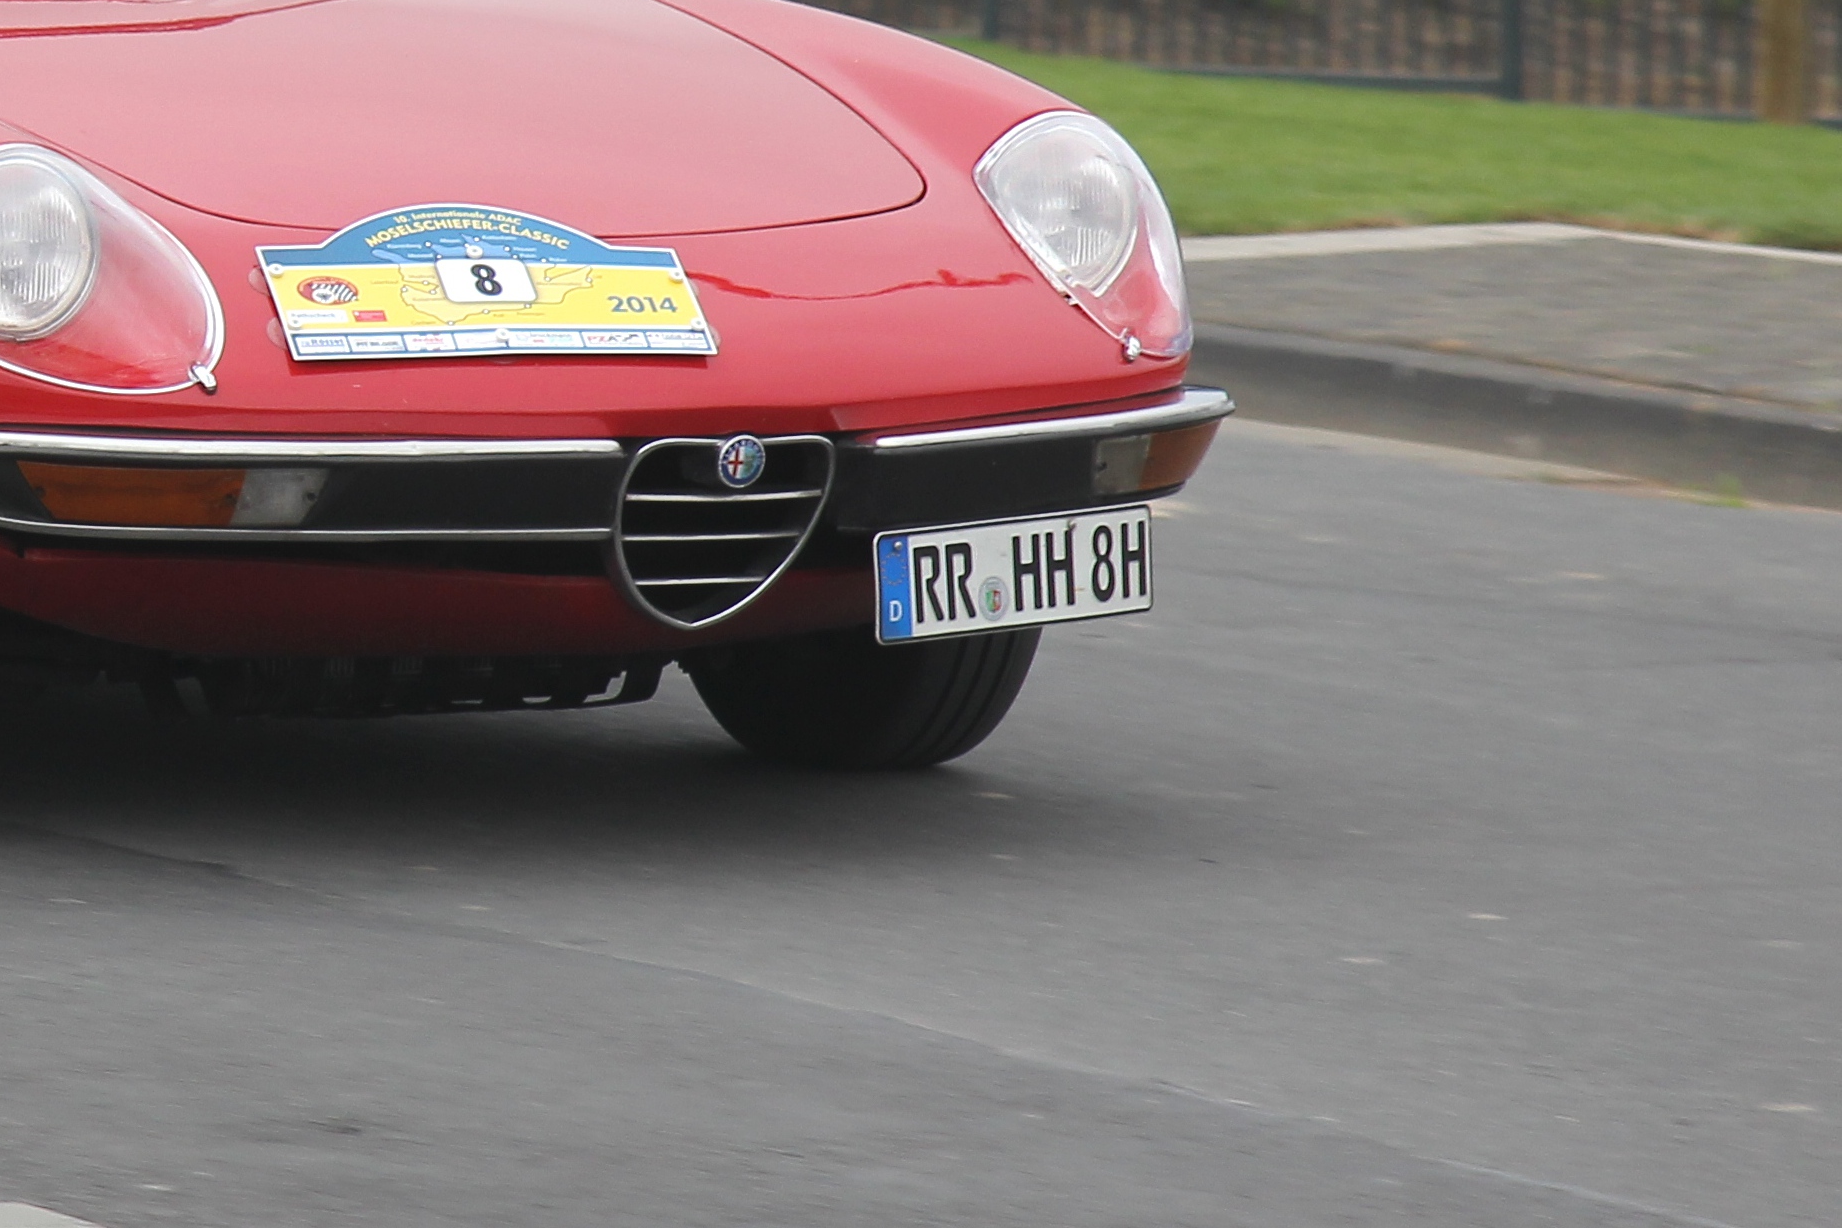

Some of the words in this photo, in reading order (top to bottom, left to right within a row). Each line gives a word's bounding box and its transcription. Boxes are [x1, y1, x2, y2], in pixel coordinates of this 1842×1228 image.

[488, 213, 522, 226] ADAC
[364, 218, 570, 250] MOSELSCHIEFER-CLASSIC
[470, 263, 503, 296] 8
[607, 295, 678, 313] 2014
[913, 542, 976, 623] RR
[1012, 528, 1075, 612] HH
[1091, 520, 1147, 602] 8H
[889, 600, 903, 622] D
